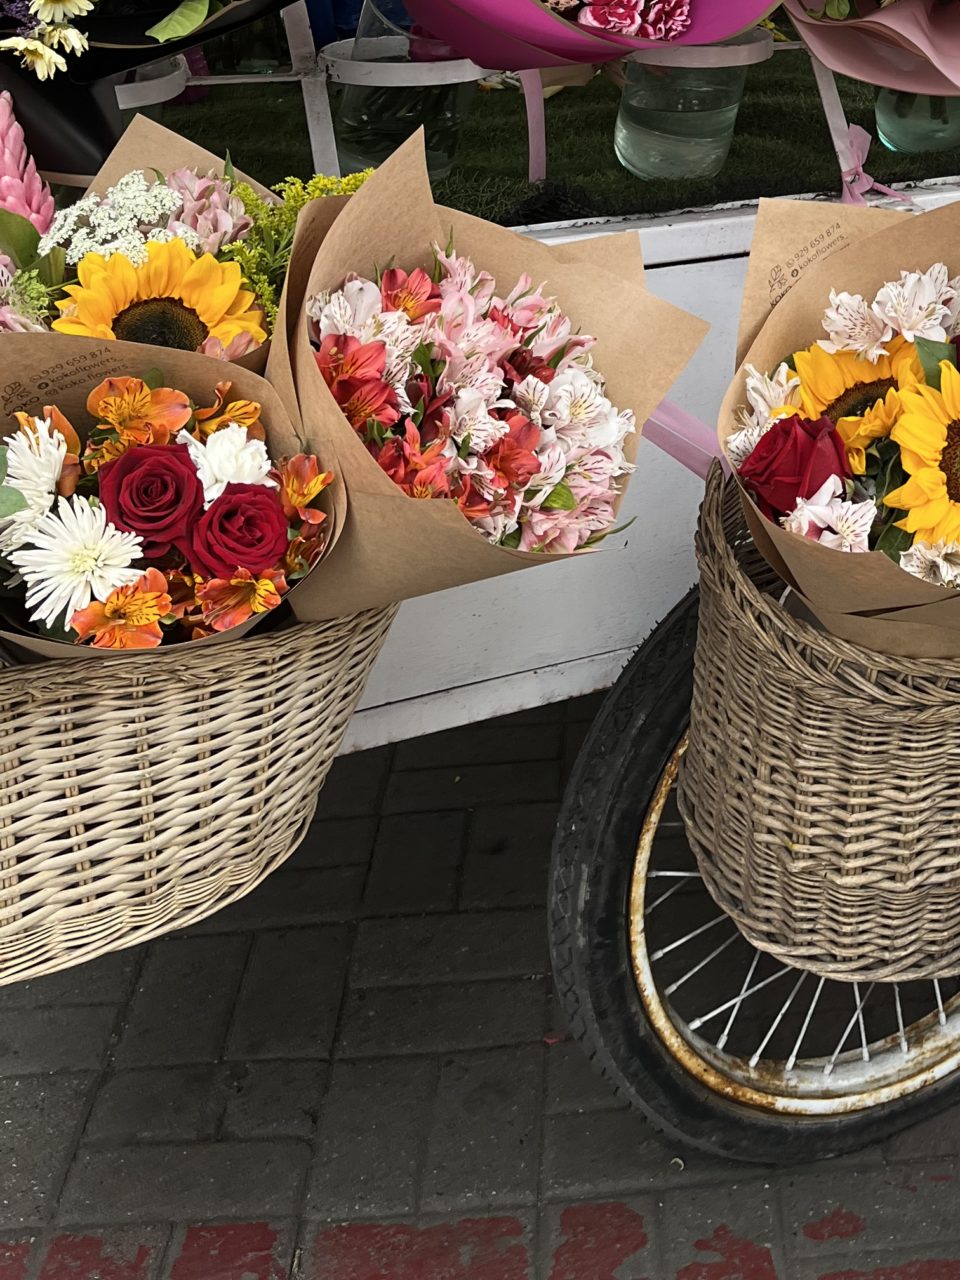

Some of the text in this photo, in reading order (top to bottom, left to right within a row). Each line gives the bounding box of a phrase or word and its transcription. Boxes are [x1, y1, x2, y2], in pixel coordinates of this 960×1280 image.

[794, 222, 841, 261] 929 659 874
[41, 346, 111, 376] 929 659 874
